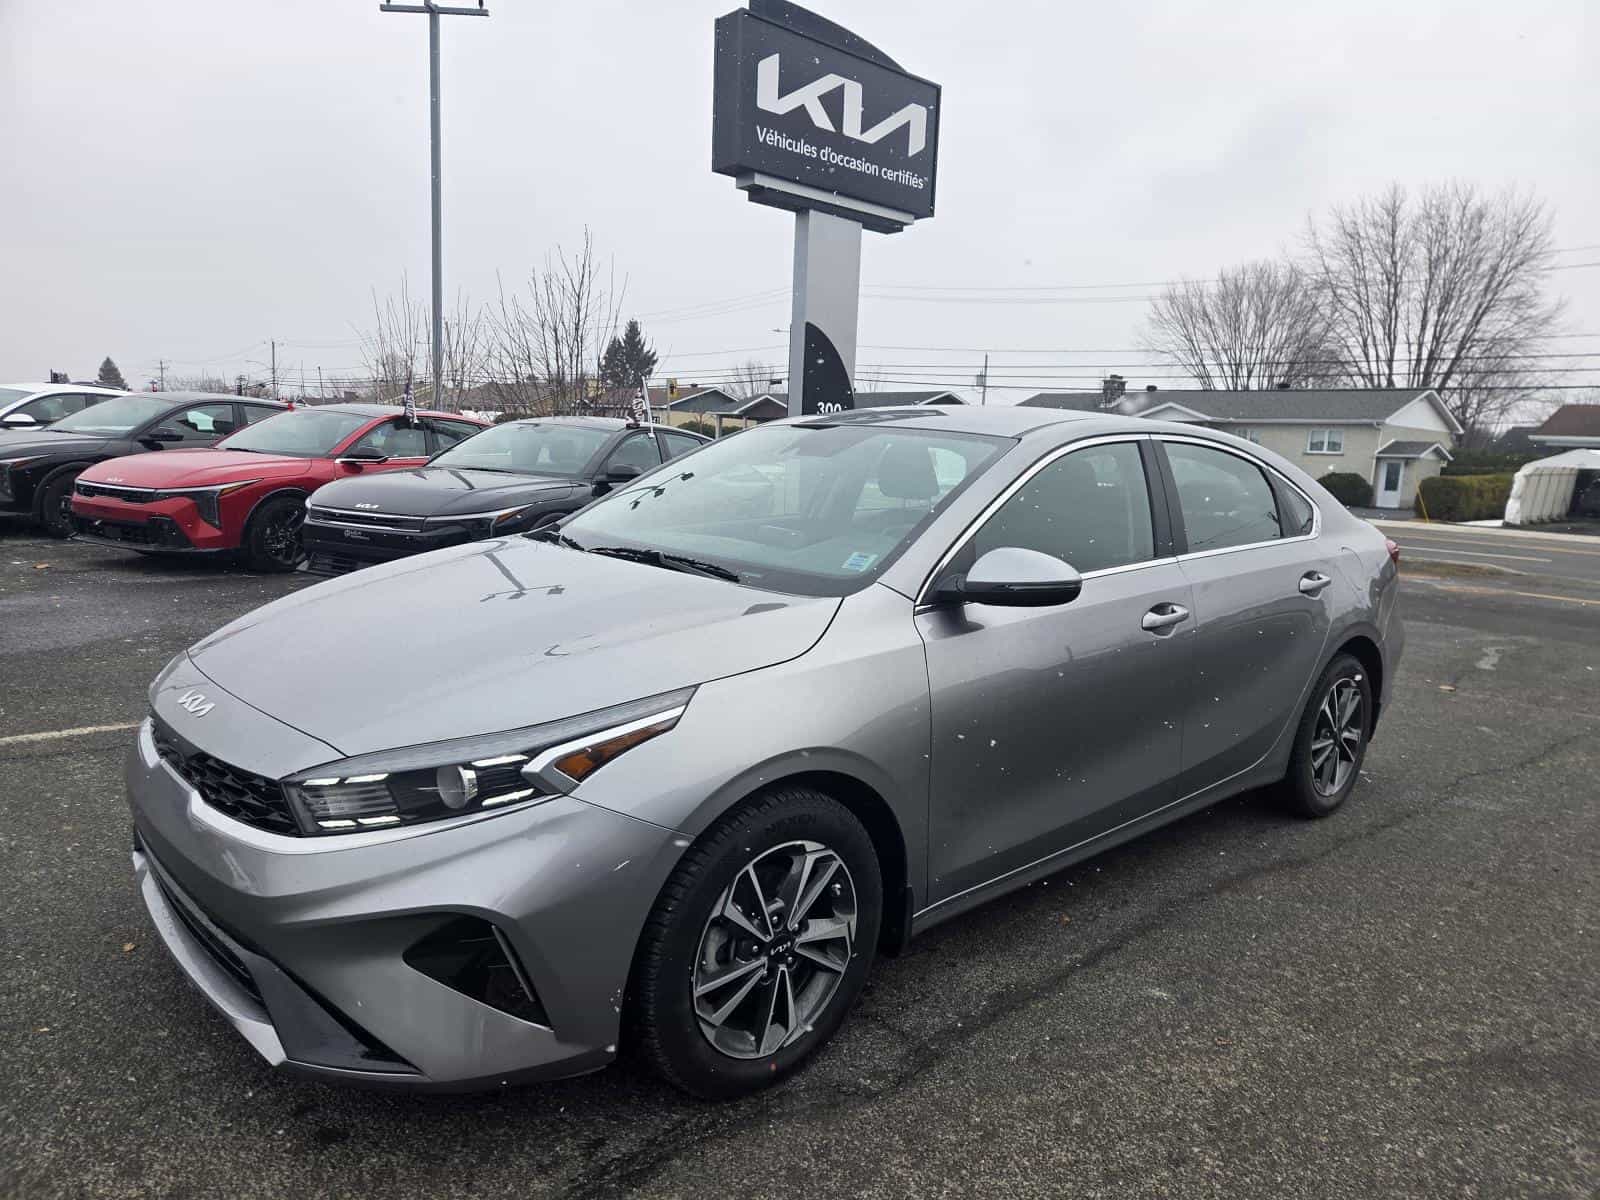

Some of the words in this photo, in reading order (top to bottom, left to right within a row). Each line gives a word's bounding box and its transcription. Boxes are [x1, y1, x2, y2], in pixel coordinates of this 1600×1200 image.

[756, 125, 818, 158] Véhicules
[820, 145, 879, 177] d'occasion
[881, 166, 924, 189] certifiés
